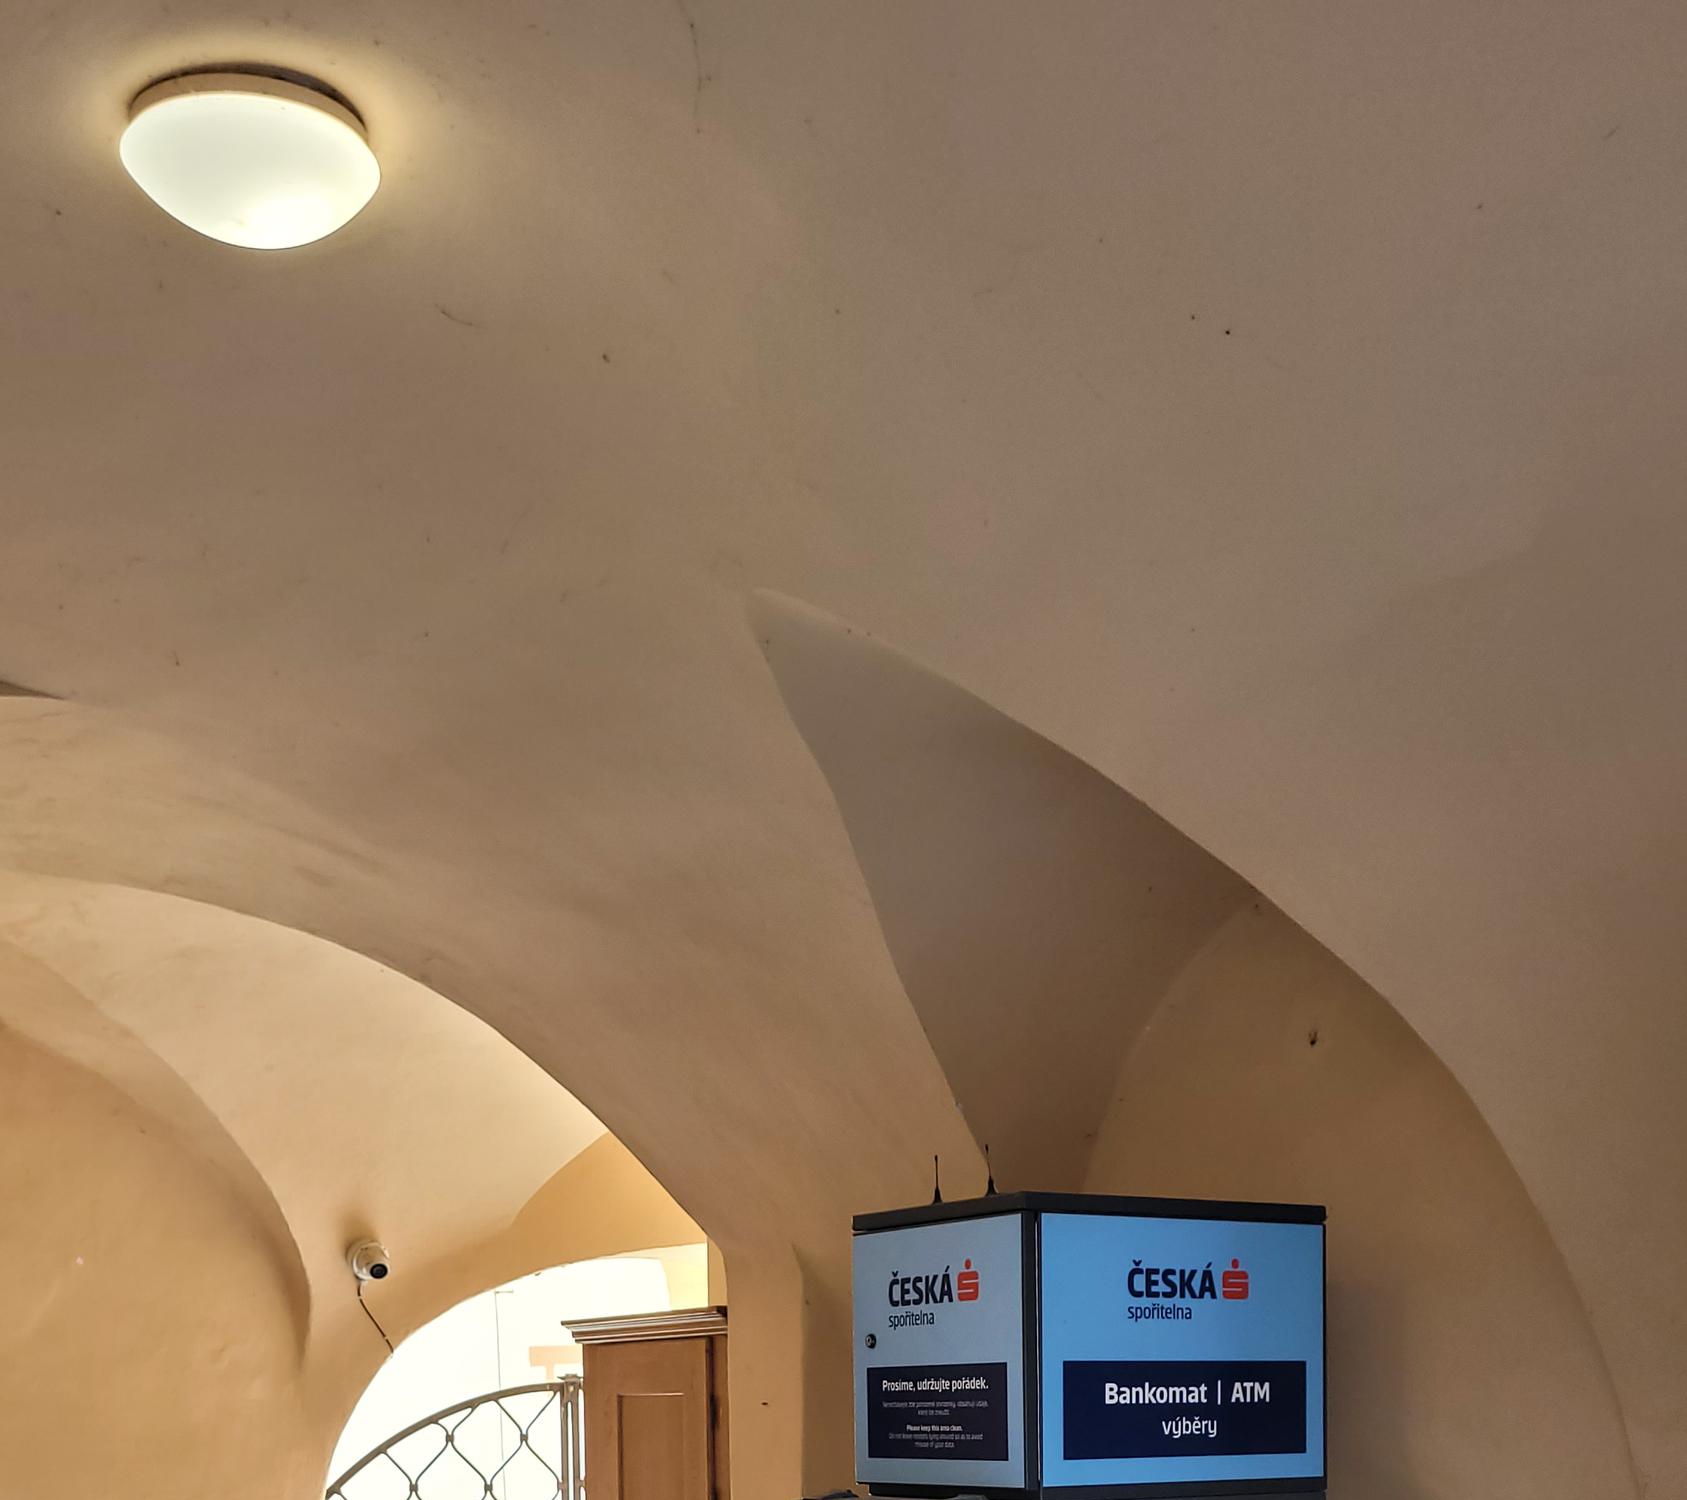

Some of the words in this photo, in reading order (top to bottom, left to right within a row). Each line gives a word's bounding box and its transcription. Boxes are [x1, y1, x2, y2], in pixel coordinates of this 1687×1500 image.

[889, 1265, 953, 1307] ČESKÁ
[1128, 1259, 1217, 1299] ČESKÁ
[889, 1310, 935, 1330] spořitelna
[1128, 1303, 1192, 1322] spořitelna
[917, 1377, 950, 1392] udržujte
[951, 1377, 989, 1392] pořádek.
[1105, 1382, 1207, 1404] Bankomat
[1231, 1382, 1270, 1403] ATM
[1162, 1416, 1217, 1438] výběry
